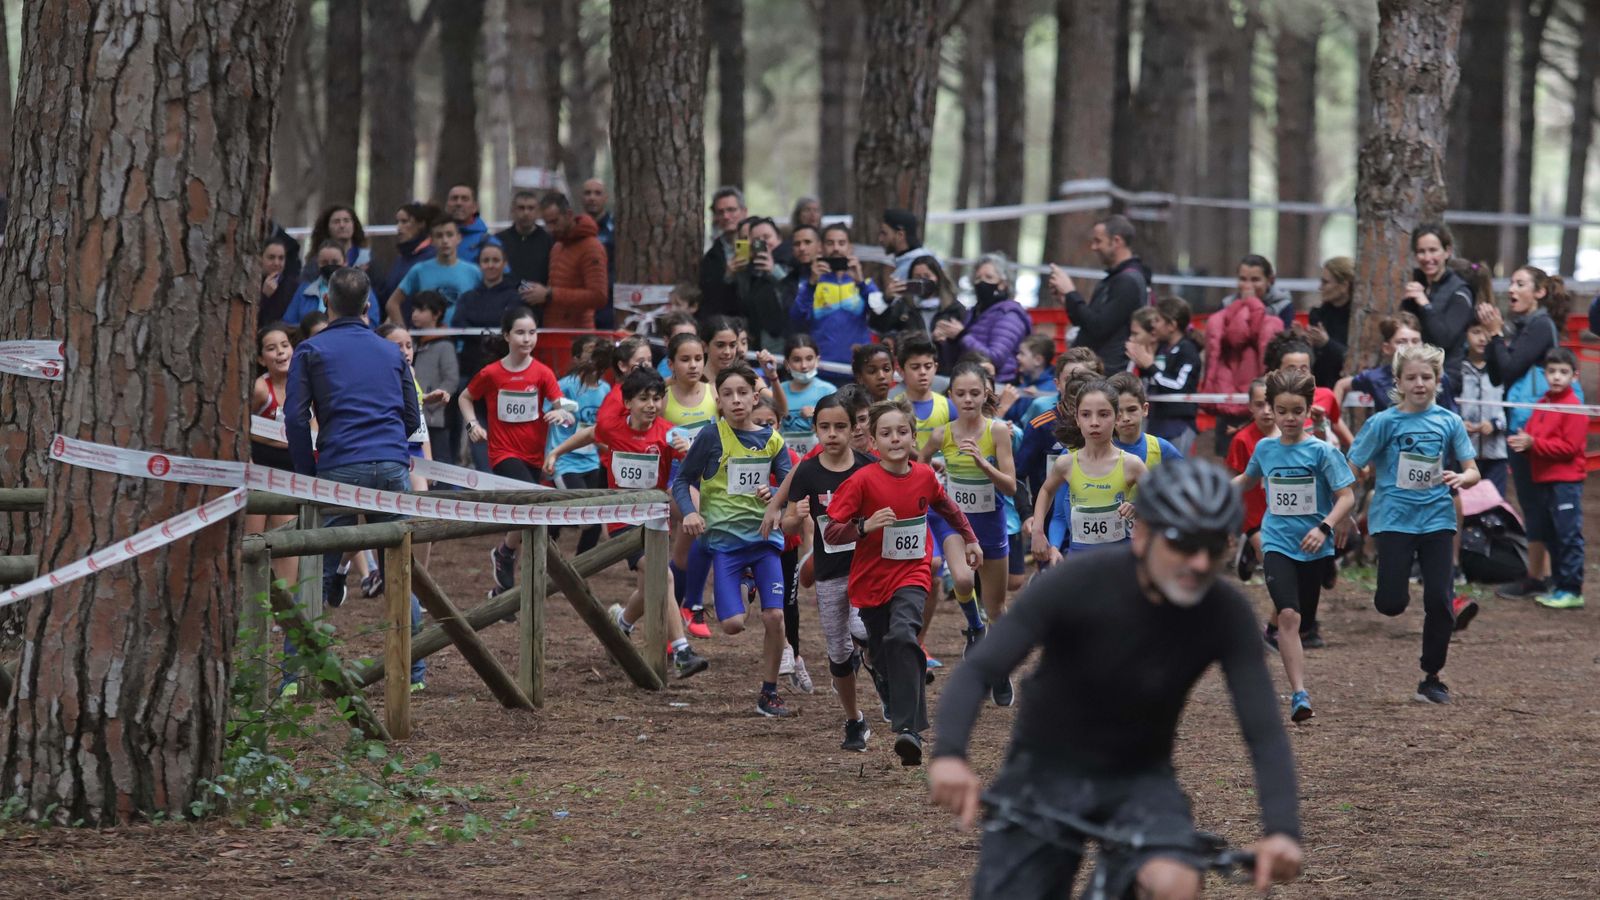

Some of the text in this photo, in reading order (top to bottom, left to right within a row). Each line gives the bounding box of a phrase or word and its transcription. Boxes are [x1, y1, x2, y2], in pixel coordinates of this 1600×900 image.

[507, 403, 525, 414] 660
[620, 467, 642, 479] 659
[740, 472, 760, 485] 512
[1409, 469, 1431, 482] 698
[955, 491, 976, 504] 680
[1276, 493, 1298, 505] 582
[1083, 521, 1107, 534] 546
[896, 535, 918, 550] 682
